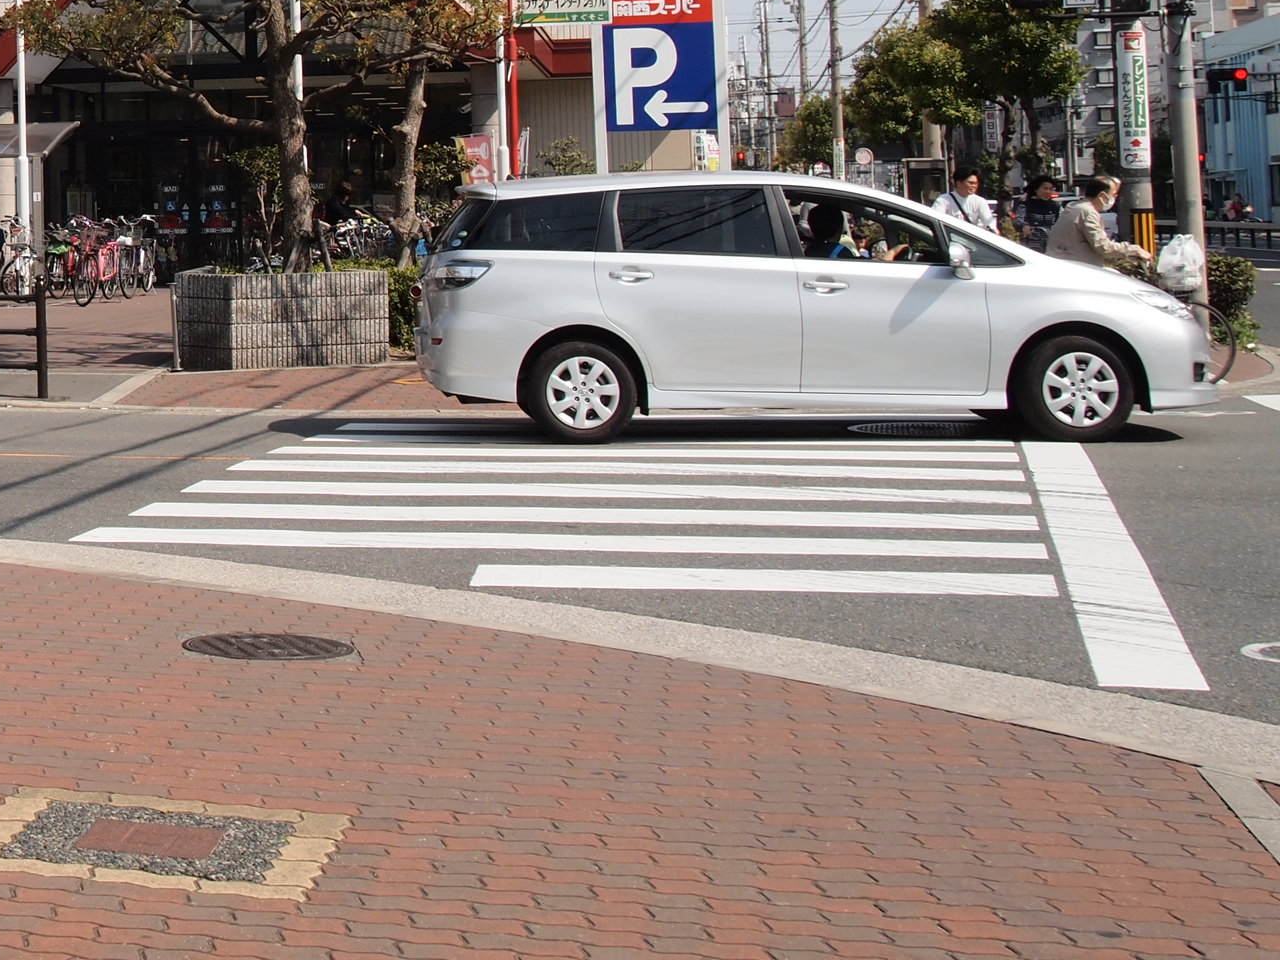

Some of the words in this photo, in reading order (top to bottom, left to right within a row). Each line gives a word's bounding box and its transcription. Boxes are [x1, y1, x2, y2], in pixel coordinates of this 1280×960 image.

[613, 0, 701, 16] 関西スーパー
[613, 28, 677, 126] P
[1133, 56, 1145, 126] フレンドマート
